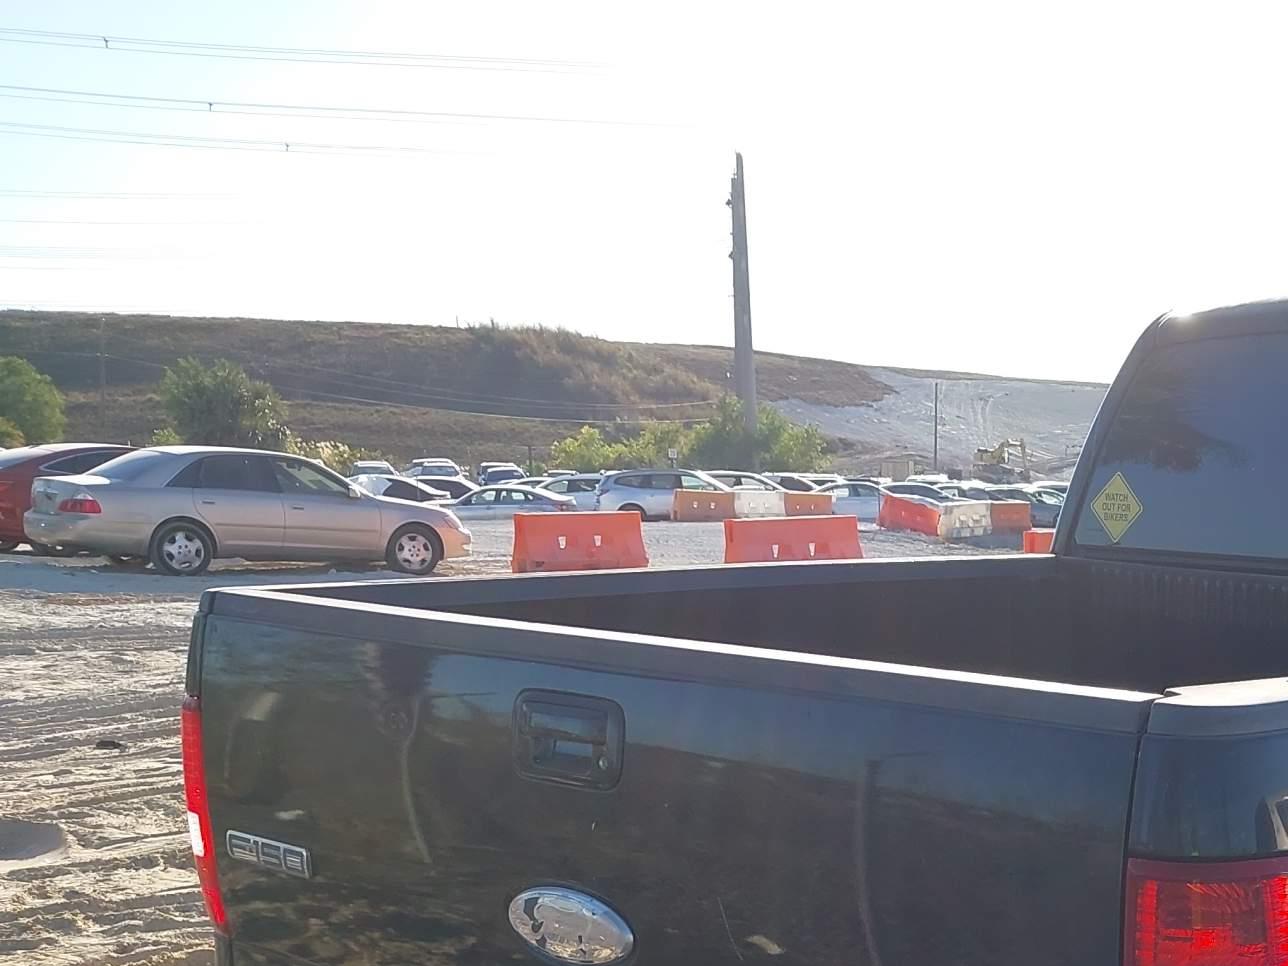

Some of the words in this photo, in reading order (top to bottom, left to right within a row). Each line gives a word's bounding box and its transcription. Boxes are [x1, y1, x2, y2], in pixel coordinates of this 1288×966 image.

[1105, 492, 1128, 502] WATCH
[1102, 503, 1115, 511] OUT
[1117, 503, 1131, 512] FOR
[1104, 512, 1128, 521] BIKERS
